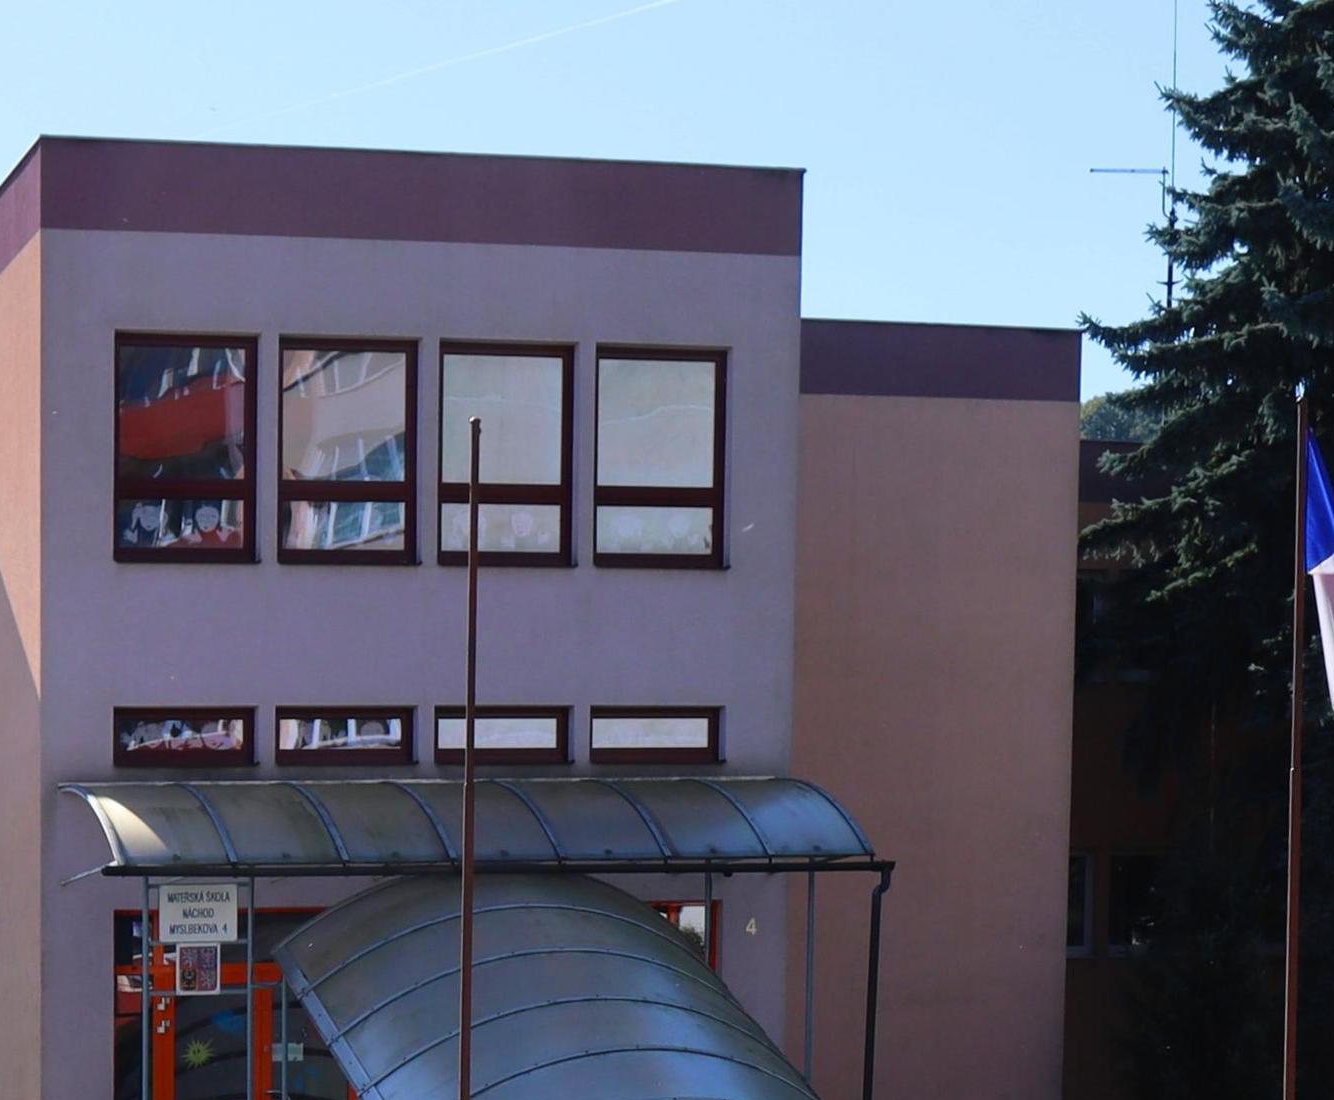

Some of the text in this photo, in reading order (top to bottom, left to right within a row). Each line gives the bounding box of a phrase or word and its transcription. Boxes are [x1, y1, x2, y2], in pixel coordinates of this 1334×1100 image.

[169, 923, 227, 934] MYSLBEKOVA 4
[745, 917, 757, 936] 4
